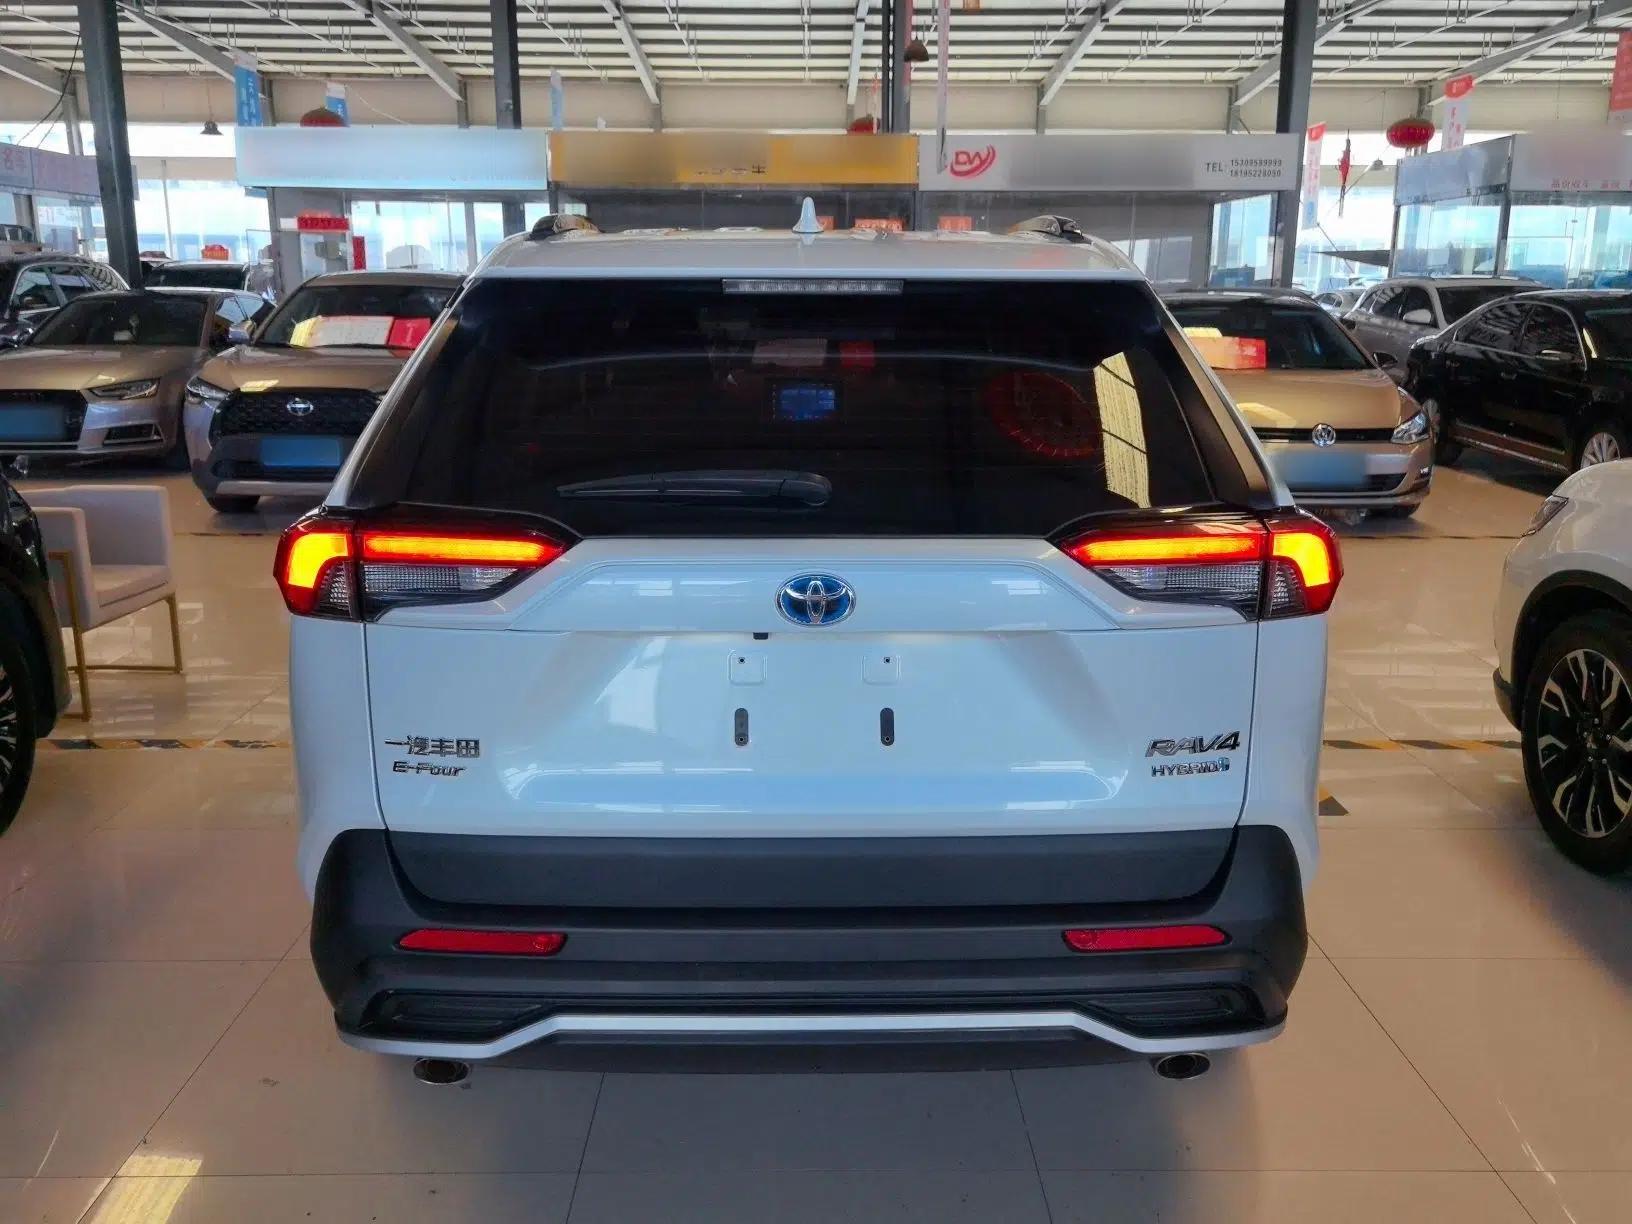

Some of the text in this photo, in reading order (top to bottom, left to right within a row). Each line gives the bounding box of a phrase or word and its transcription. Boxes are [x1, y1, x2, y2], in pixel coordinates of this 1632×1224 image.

[384, 735, 480, 758] 一汽丰田
[1145, 731, 1240, 757] RAV4
[393, 761, 465, 776] E-Four
[1151, 760, 1219, 777] HYBRID
